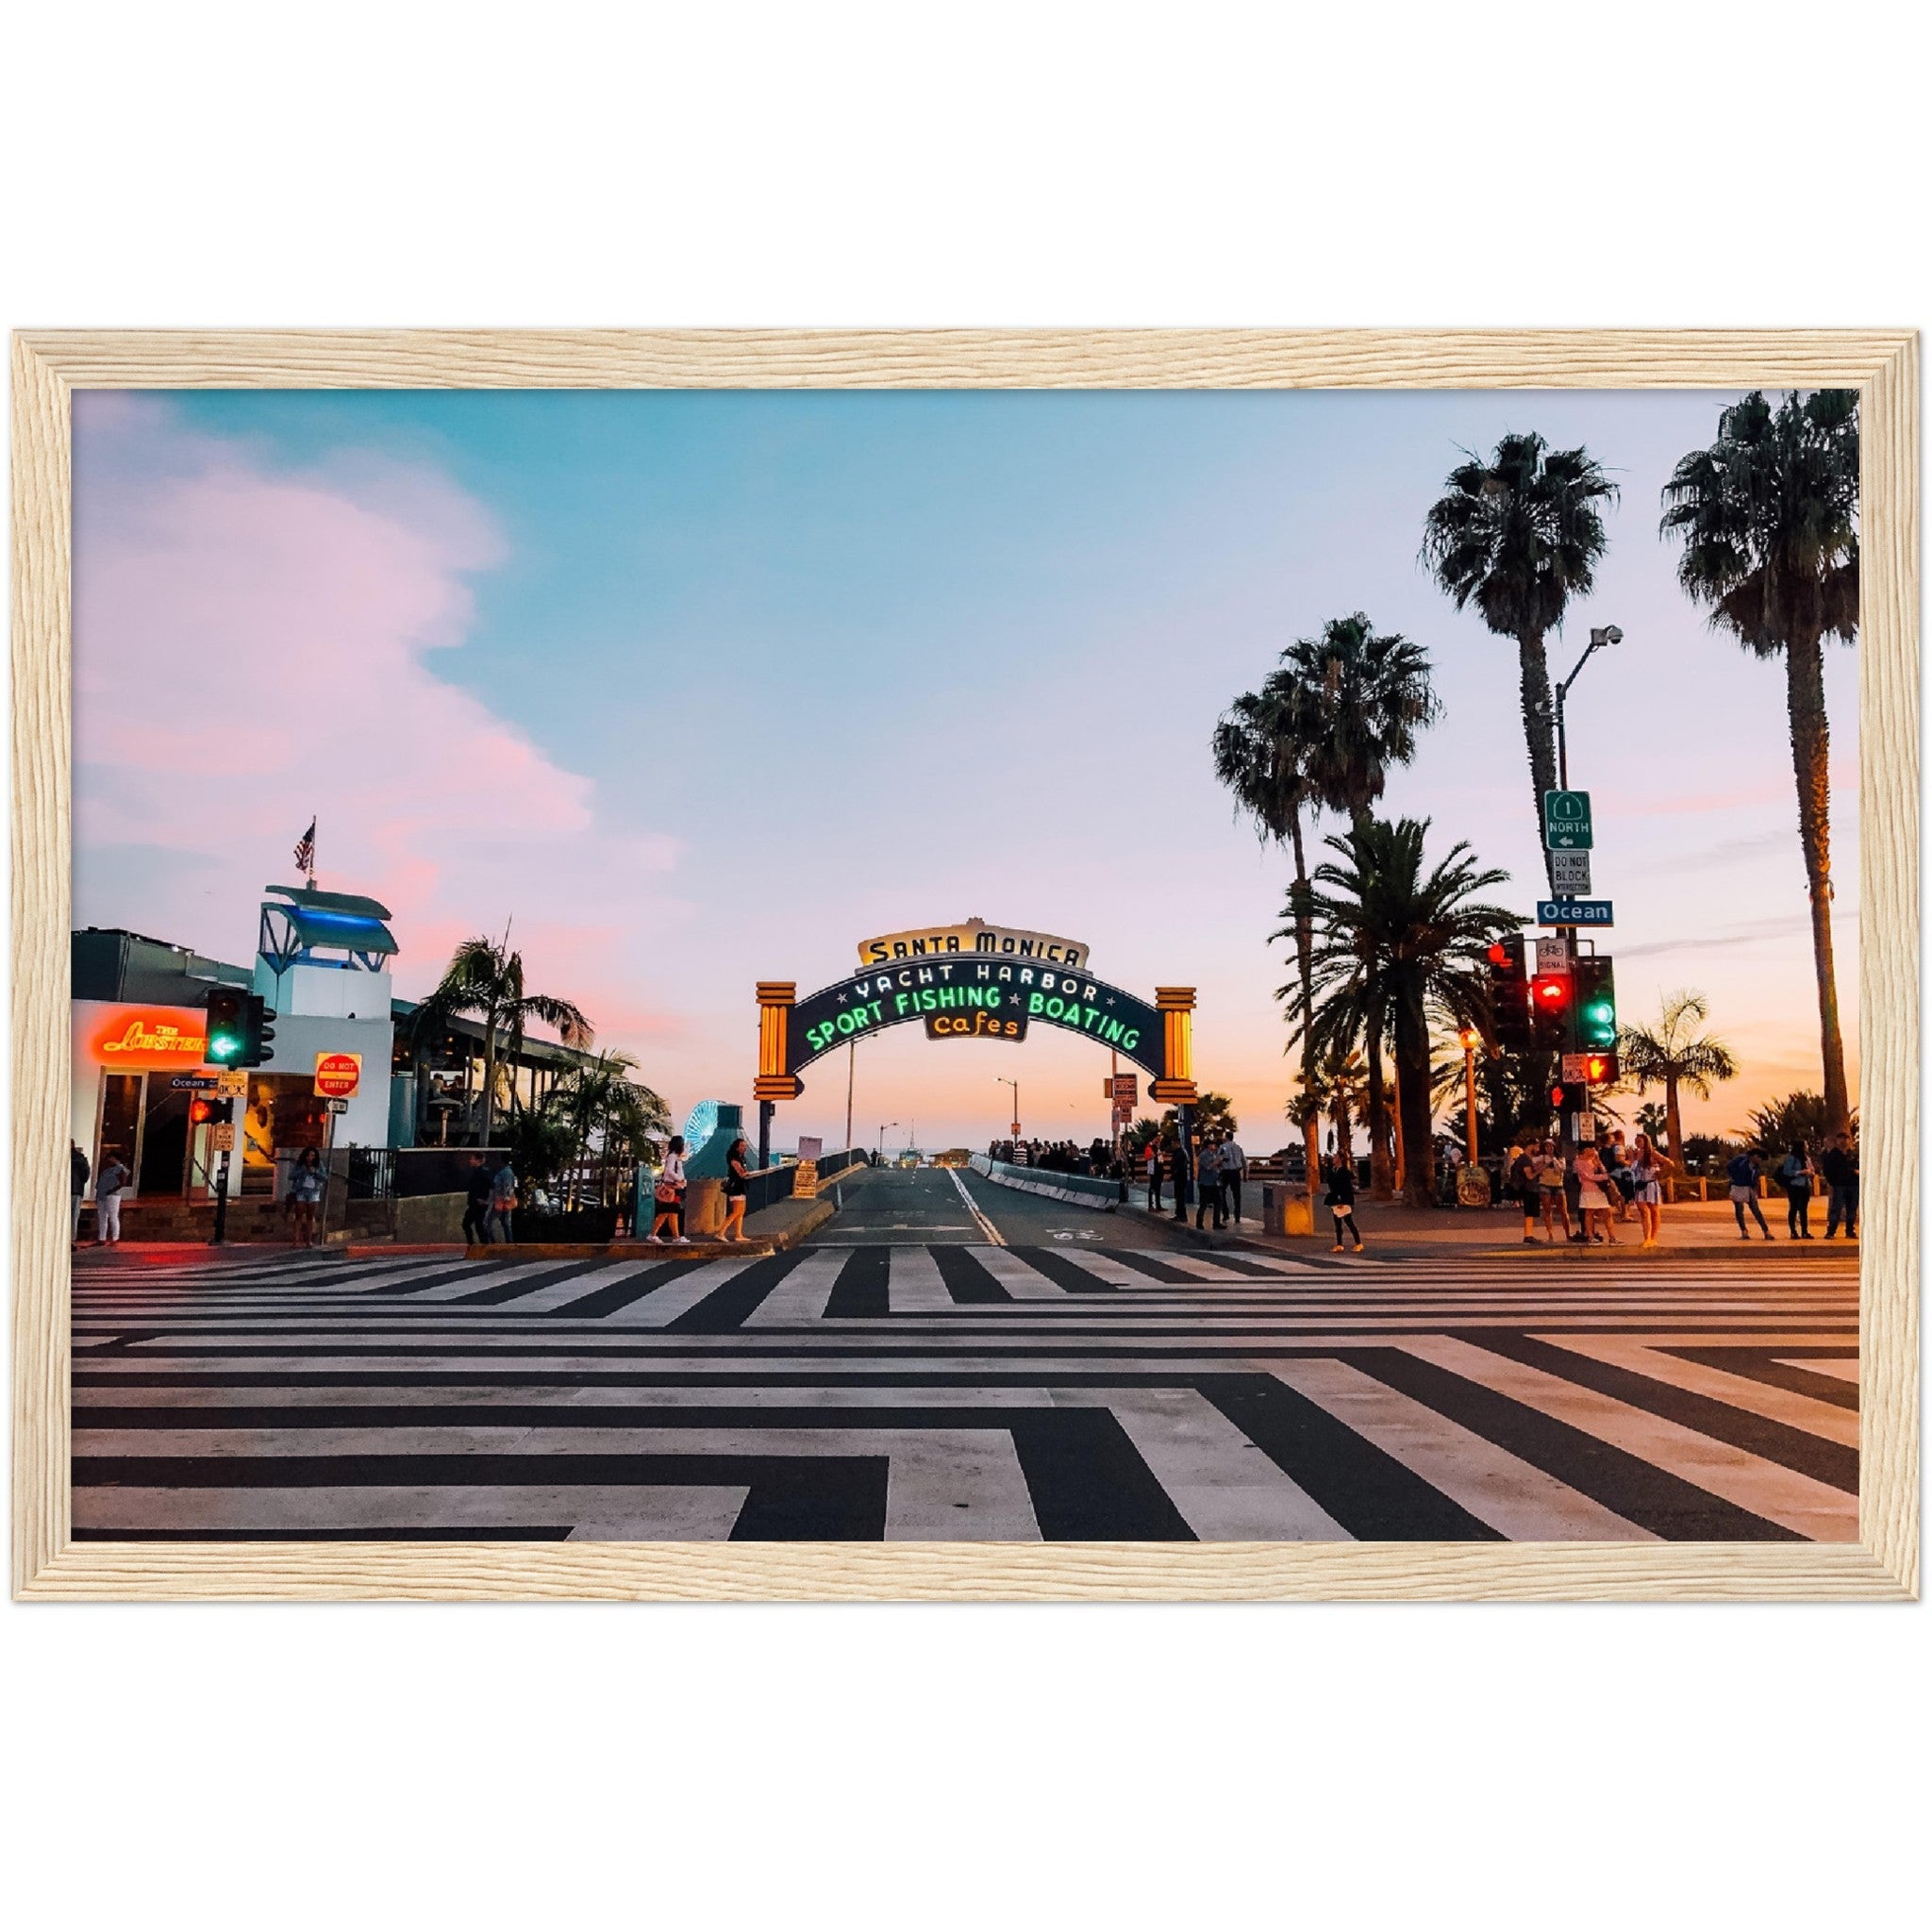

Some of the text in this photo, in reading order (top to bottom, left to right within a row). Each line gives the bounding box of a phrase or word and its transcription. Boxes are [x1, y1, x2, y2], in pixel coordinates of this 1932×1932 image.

[1565, 801, 1571, 815] 1
[1549, 822, 1590, 833] NORTH
[1555, 857, 1587, 867] DO NOT
[1556, 870, 1588, 881] BLOCK
[1542, 903, 1608, 920] Ocean
[869, 931, 1080, 966] SANTA MONICA
[1539, 961, 1565, 970] SIGNAL
[855, 964, 1097, 1002] YACHT HARBOR
[805, 986, 1141, 1051] SPORT FISHING BOATING
[156, 1024, 178, 1036] THE
[324, 1061, 355, 1071] DO NOT
[172, 1077, 205, 1087] Ocean
[325, 1080, 349, 1089] ENTER
